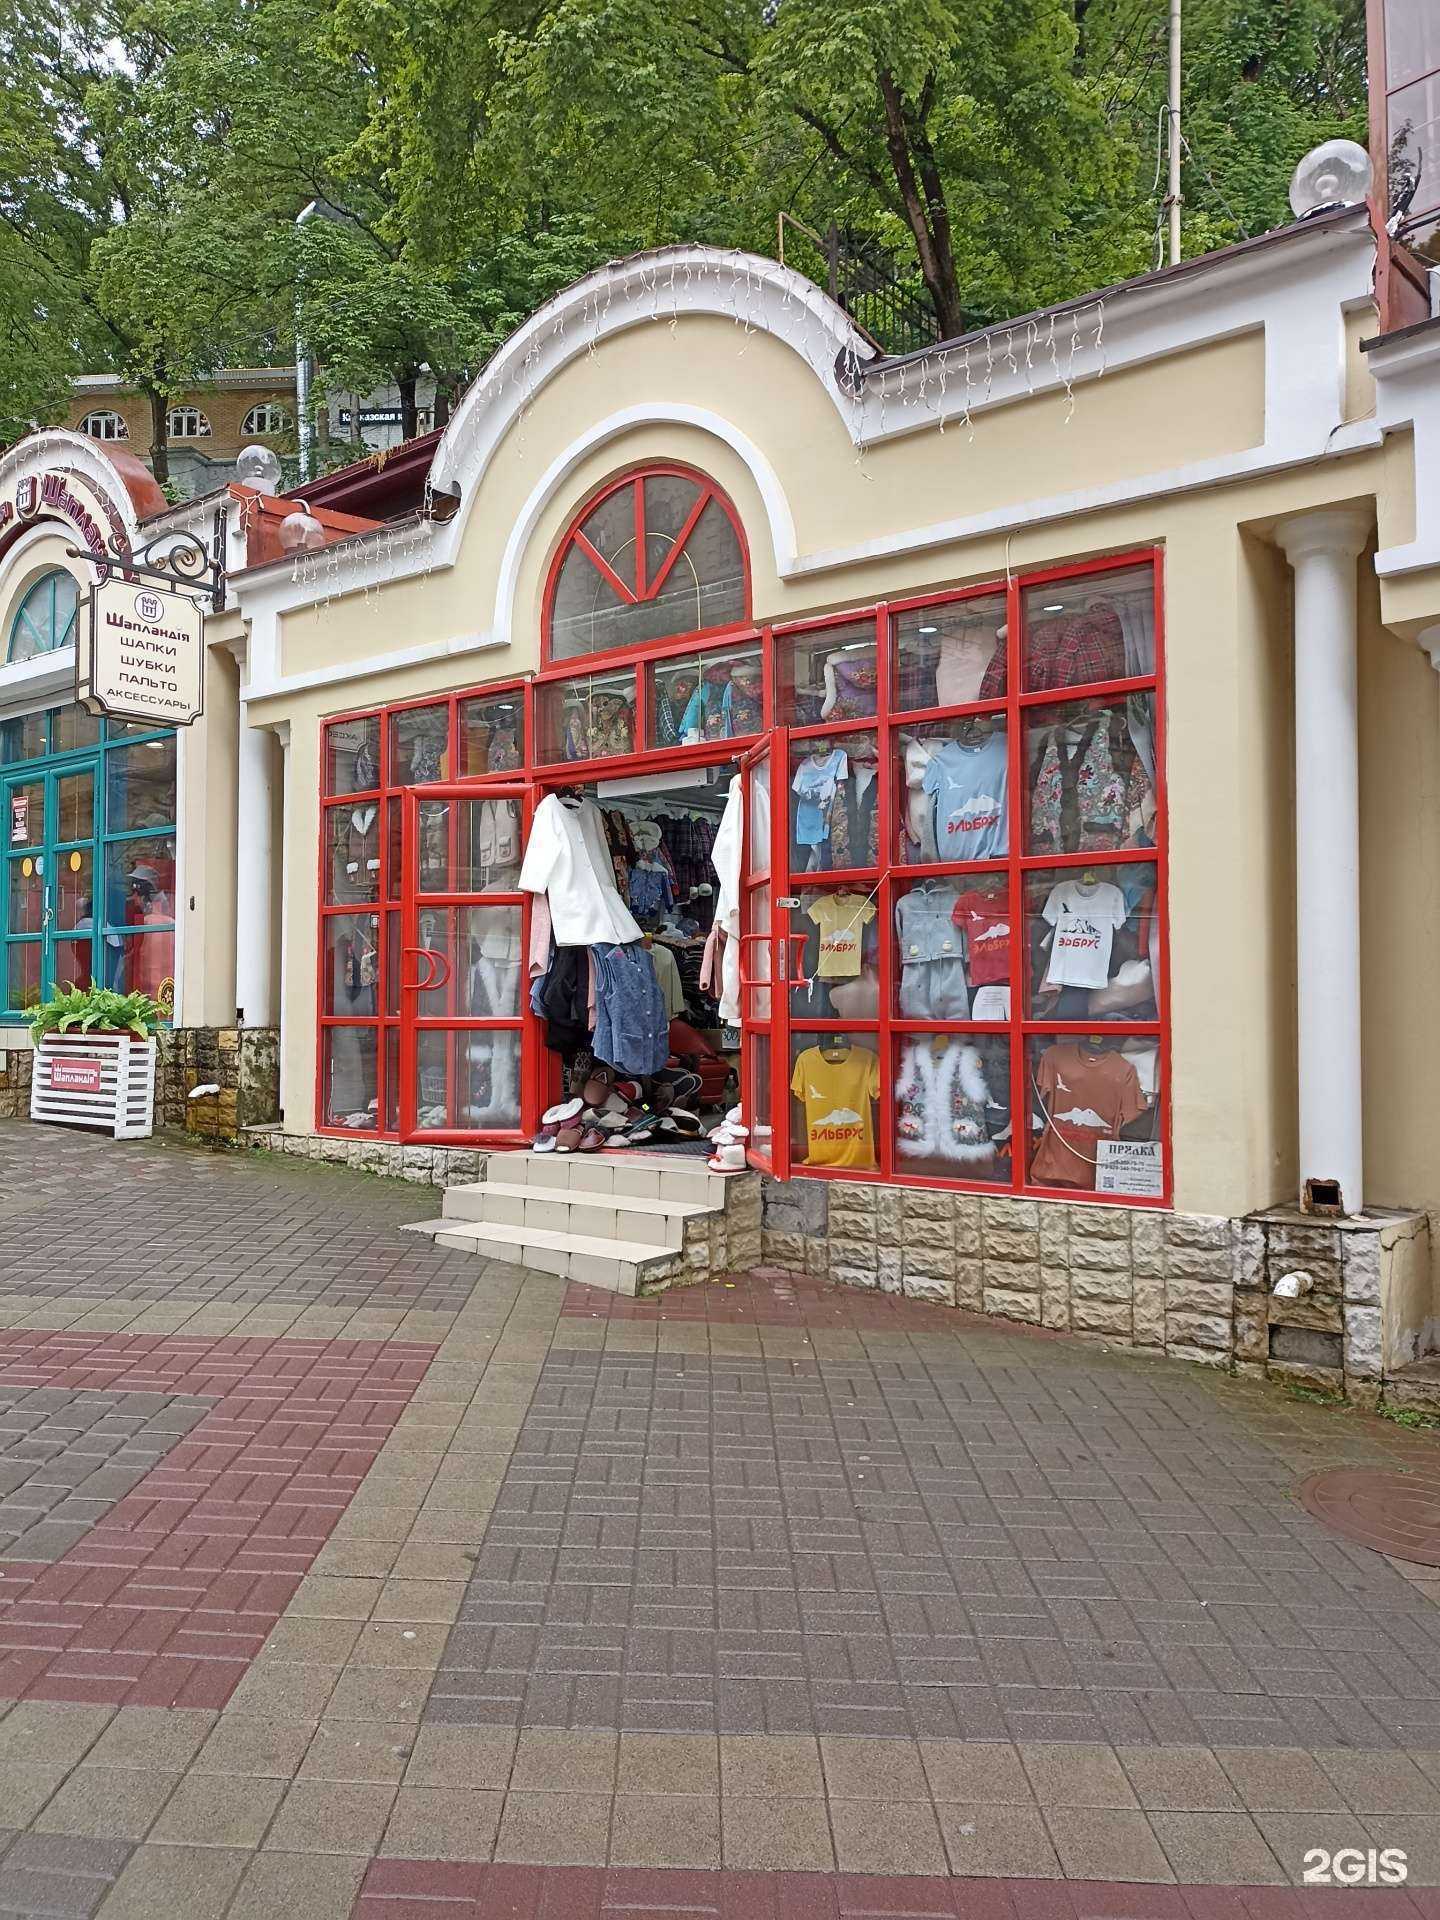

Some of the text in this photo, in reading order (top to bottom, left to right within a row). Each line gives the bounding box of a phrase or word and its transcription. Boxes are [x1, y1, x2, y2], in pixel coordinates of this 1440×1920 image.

[120, 636, 177, 656] ШАПКИ
[120, 655, 176, 674] ШУБКИ
[119, 672, 178, 692] ПАЛЬТО
[106, 688, 191, 710] АКСЕССУАРЫ
[811, 1127, 864, 1141] ЭЛЬБРУС
